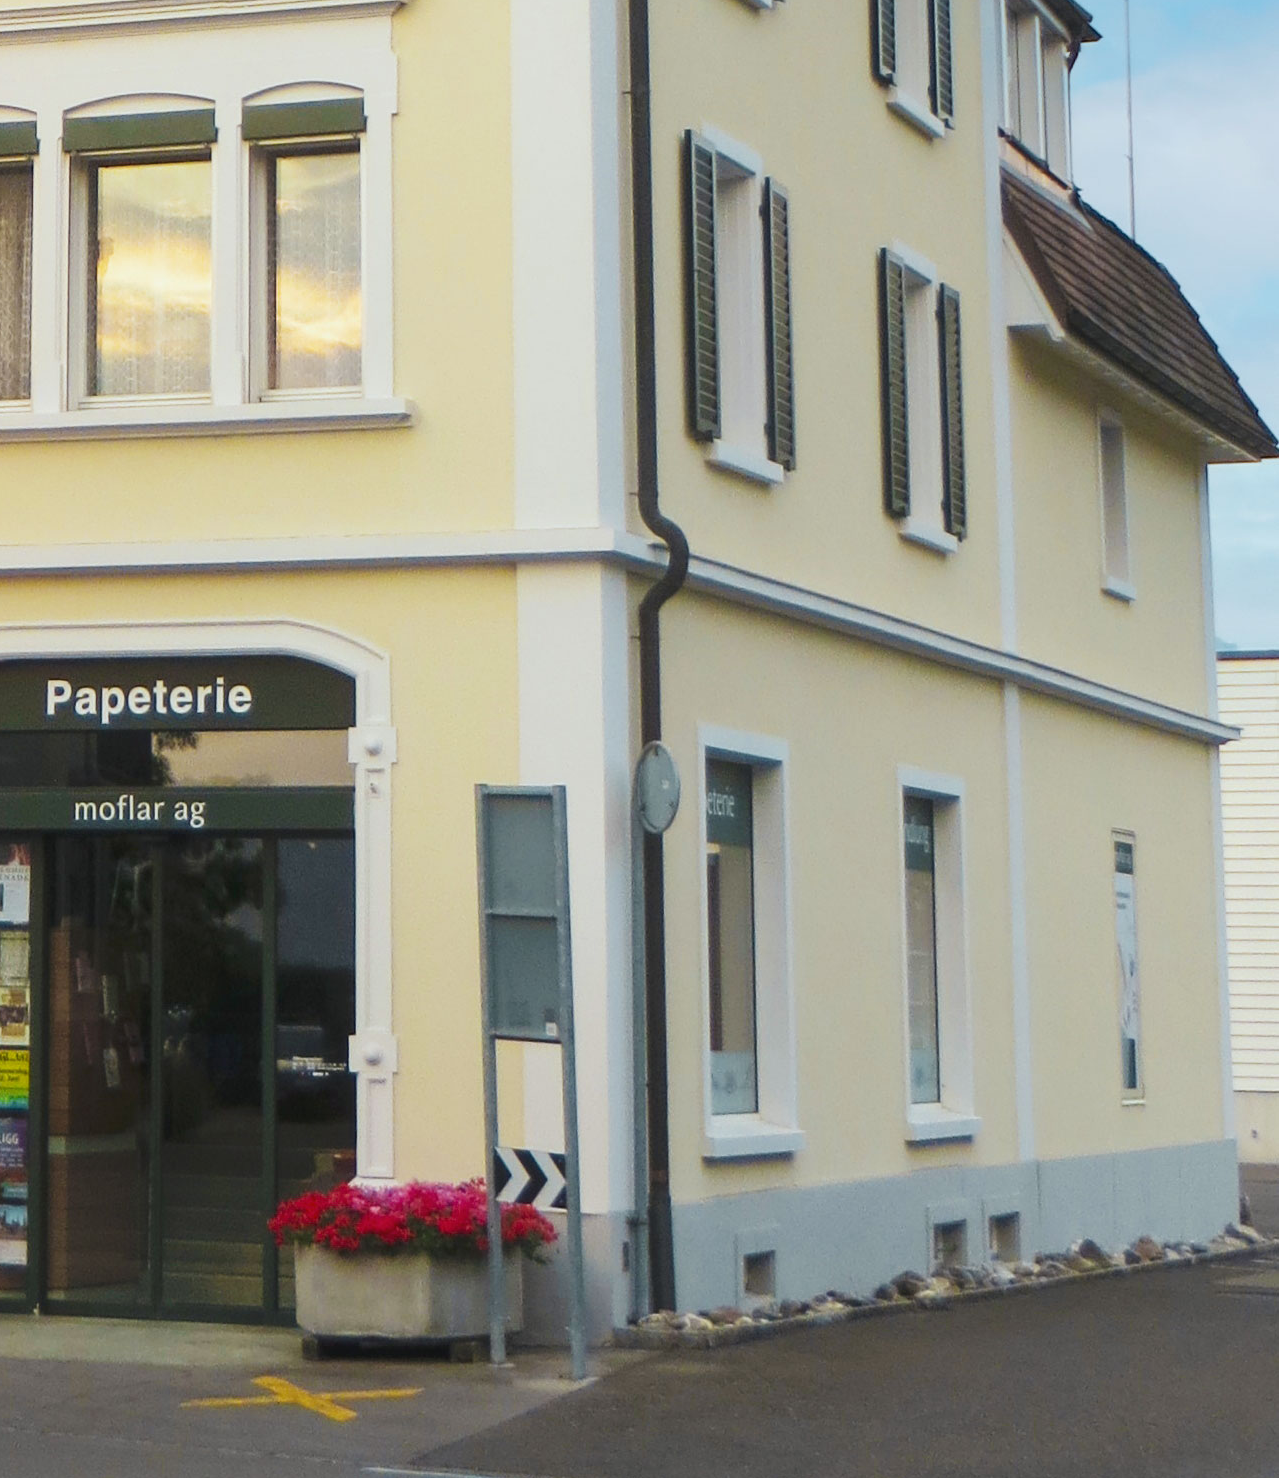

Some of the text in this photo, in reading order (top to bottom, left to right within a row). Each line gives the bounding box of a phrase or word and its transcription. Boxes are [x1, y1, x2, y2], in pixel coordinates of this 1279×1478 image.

[46, 677, 252, 724] Papeterie
[74, 794, 206, 829] moflar ag
